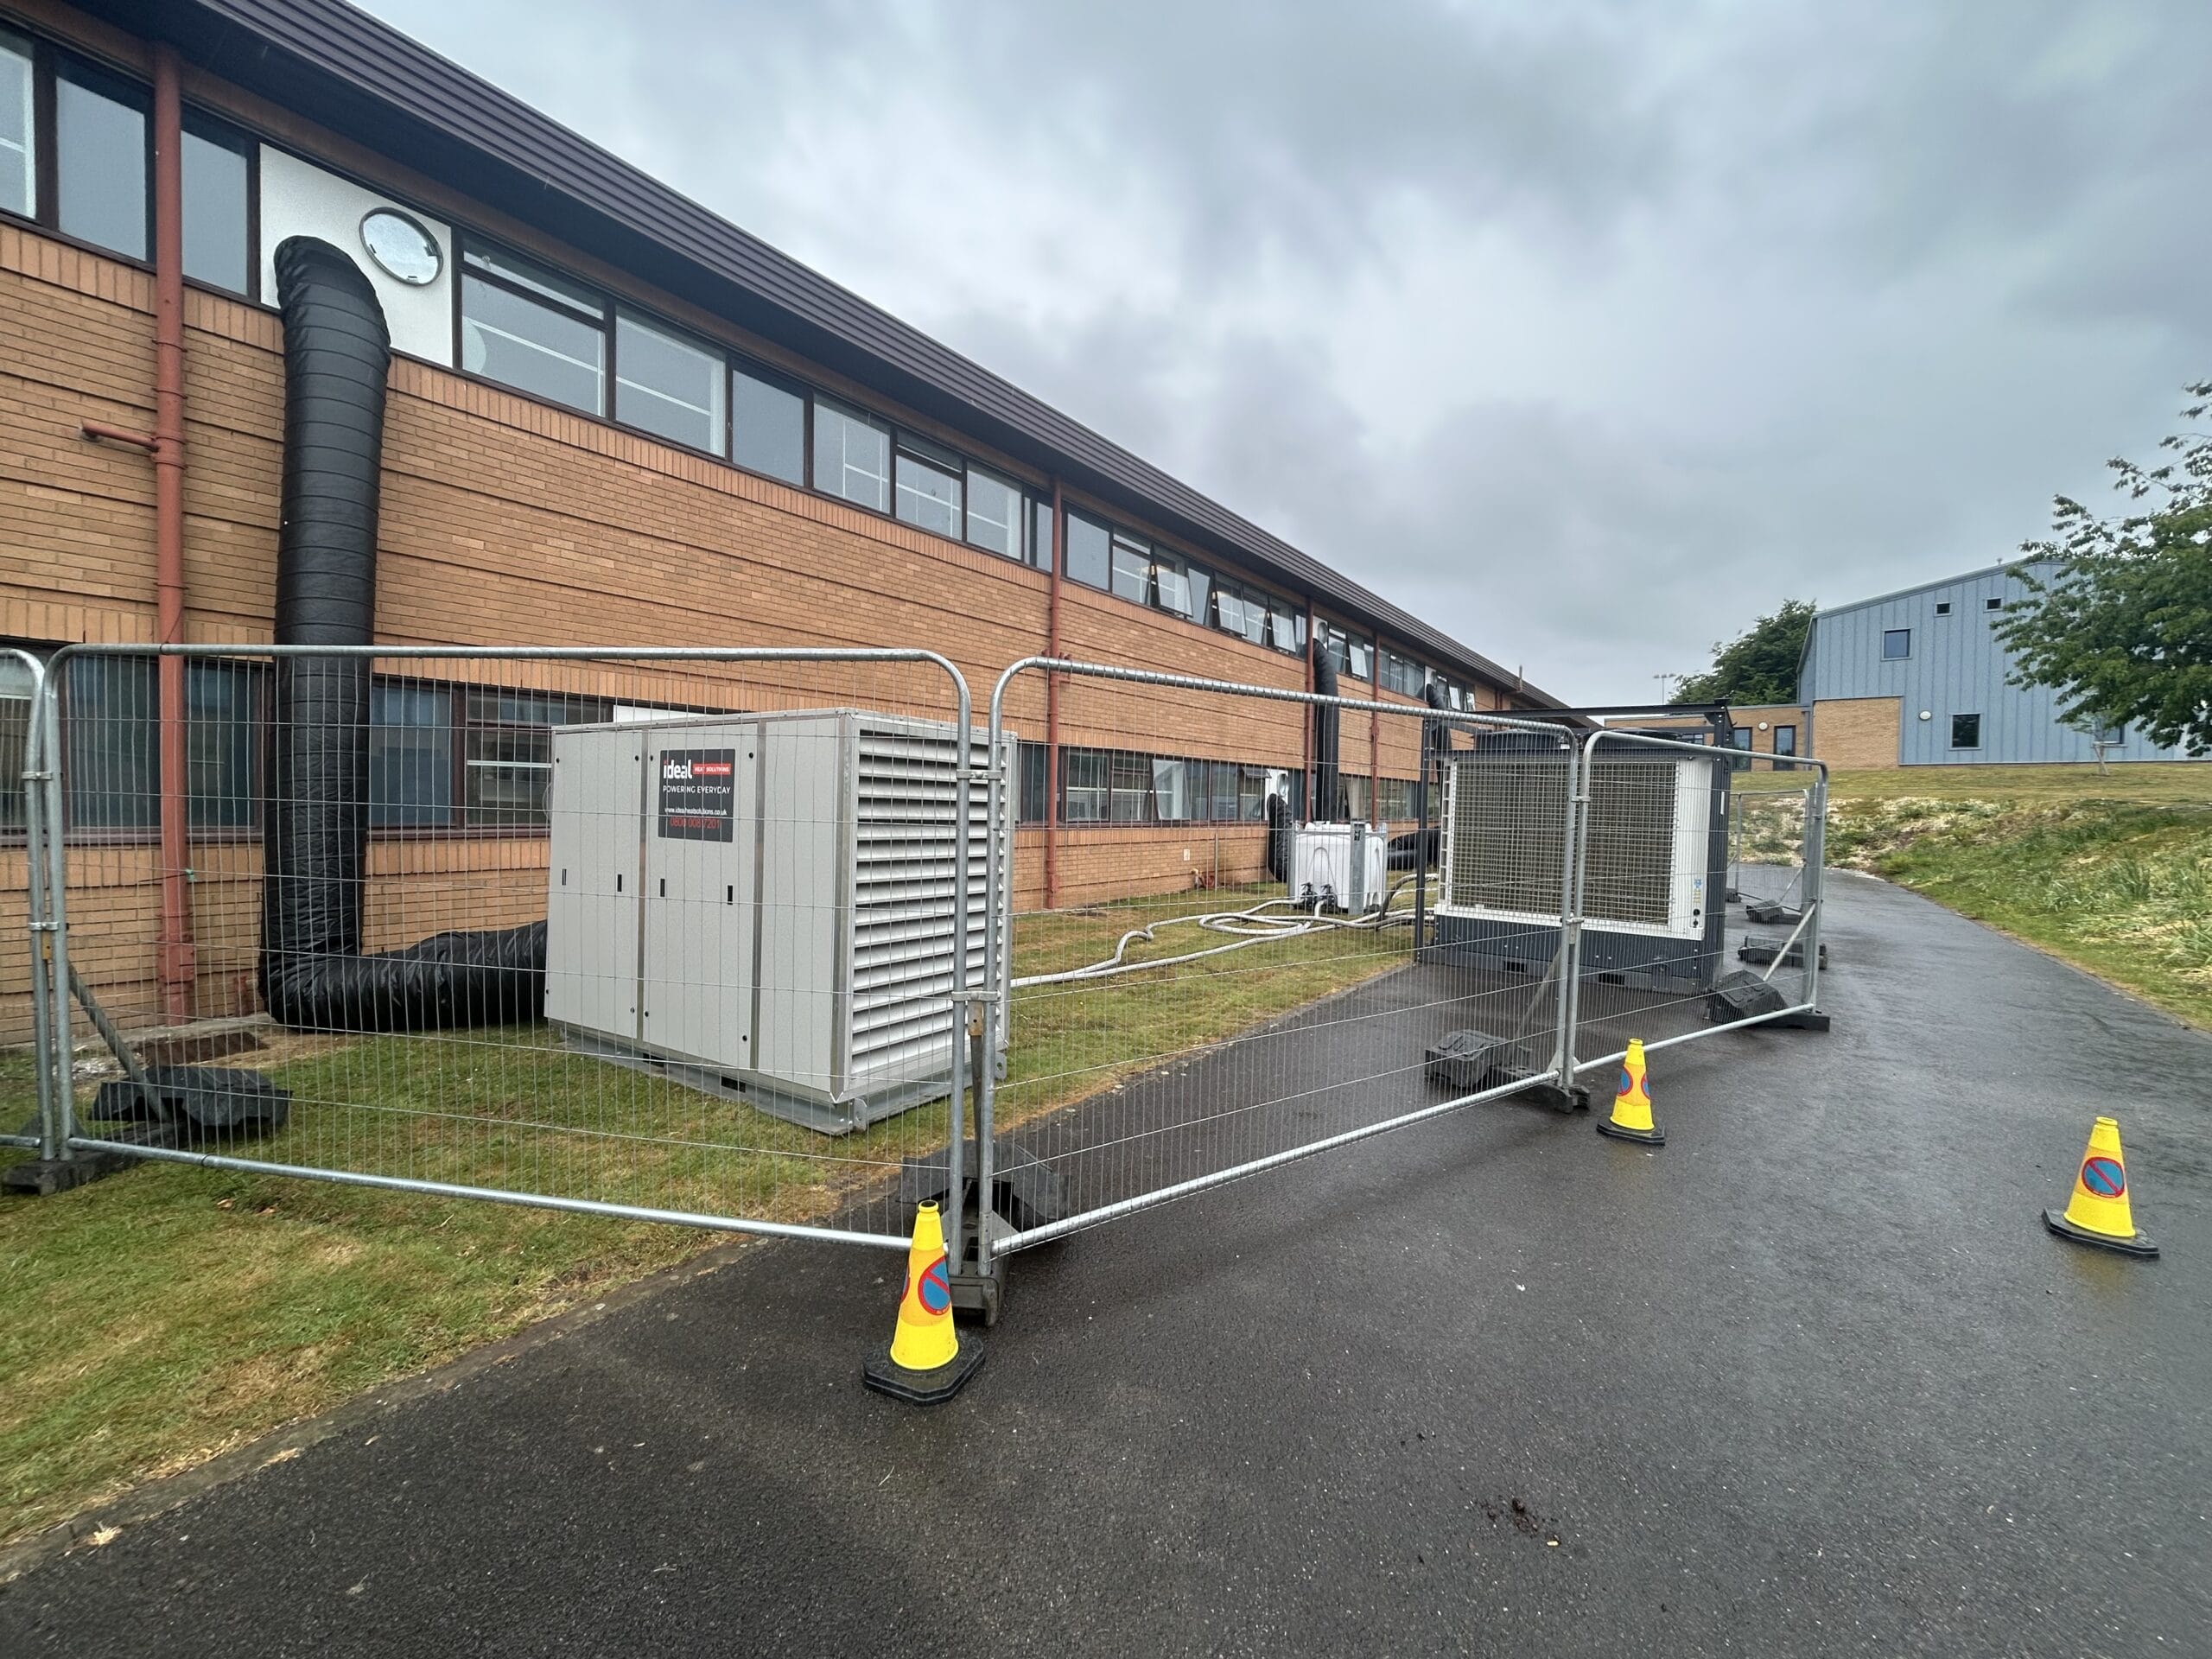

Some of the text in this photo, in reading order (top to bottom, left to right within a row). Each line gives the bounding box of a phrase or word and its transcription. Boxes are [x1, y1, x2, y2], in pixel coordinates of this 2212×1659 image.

[663, 760, 693, 779] ideal
[697, 785, 731, 794] EVERYDAY
[671, 817, 720, 829] 0800 008 7201
